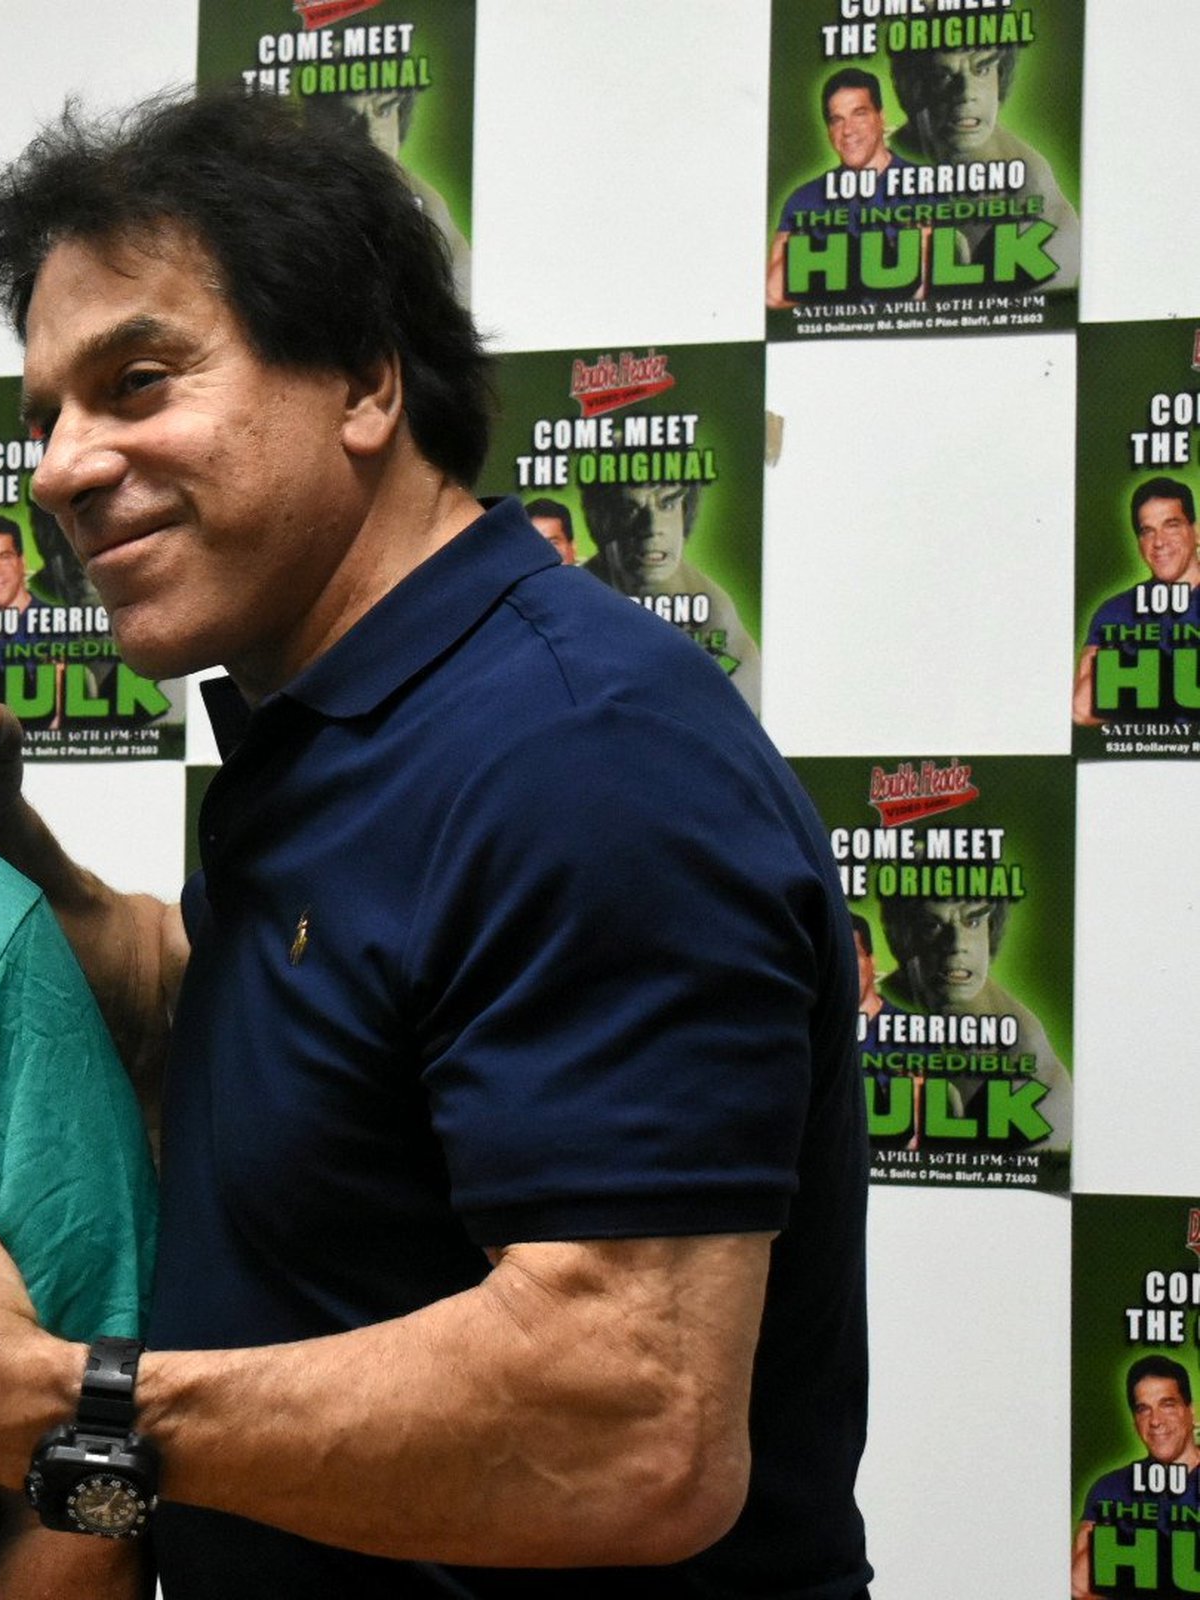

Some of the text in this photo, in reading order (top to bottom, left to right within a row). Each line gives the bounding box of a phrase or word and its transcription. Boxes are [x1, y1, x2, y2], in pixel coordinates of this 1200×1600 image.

[259, 24, 414, 64] COME MEET
[822, 11, 1035, 55] THE ORIGINAL
[242, 58, 431, 96] THE ORIGINAL
[826, 160, 1025, 200] LOU FERRIGNO
[793, 195, 1044, 227] THE INCREDIBLE
[788, 219, 1059, 293] HULK
[792, 304, 876, 318] SATURDAY
[883, 301, 928, 314] APRIL
[1151, 392, 1200, 426] CO
[534, 415, 698, 450] COME MEET
[1131, 431, 1189, 464] THE
[516, 450, 716, 486] THE ORIGINAL
[1136, 584, 1189, 614] LOU
[27, 606, 109, 633] FERRIG
[1101, 624, 1161, 640] THE
[6, 640, 118, 658] INCREDI
[1101, 723, 1192, 736] SATURDAY
[831, 828, 1005, 860] COME MEET
[879, 865, 1025, 897] ORIGINAL
[878, 1014, 1017, 1046] FERRIGNO
[862, 1052, 1037, 1073] NCREDIBLE
[864, 1076, 1054, 1141] ULK
[875, 1150, 922, 1163] APRIL
[1126, 1309, 1184, 1341] THE
[1133, 1463, 1187, 1494] LOU
[1098, 1500, 1159, 1520] THE
